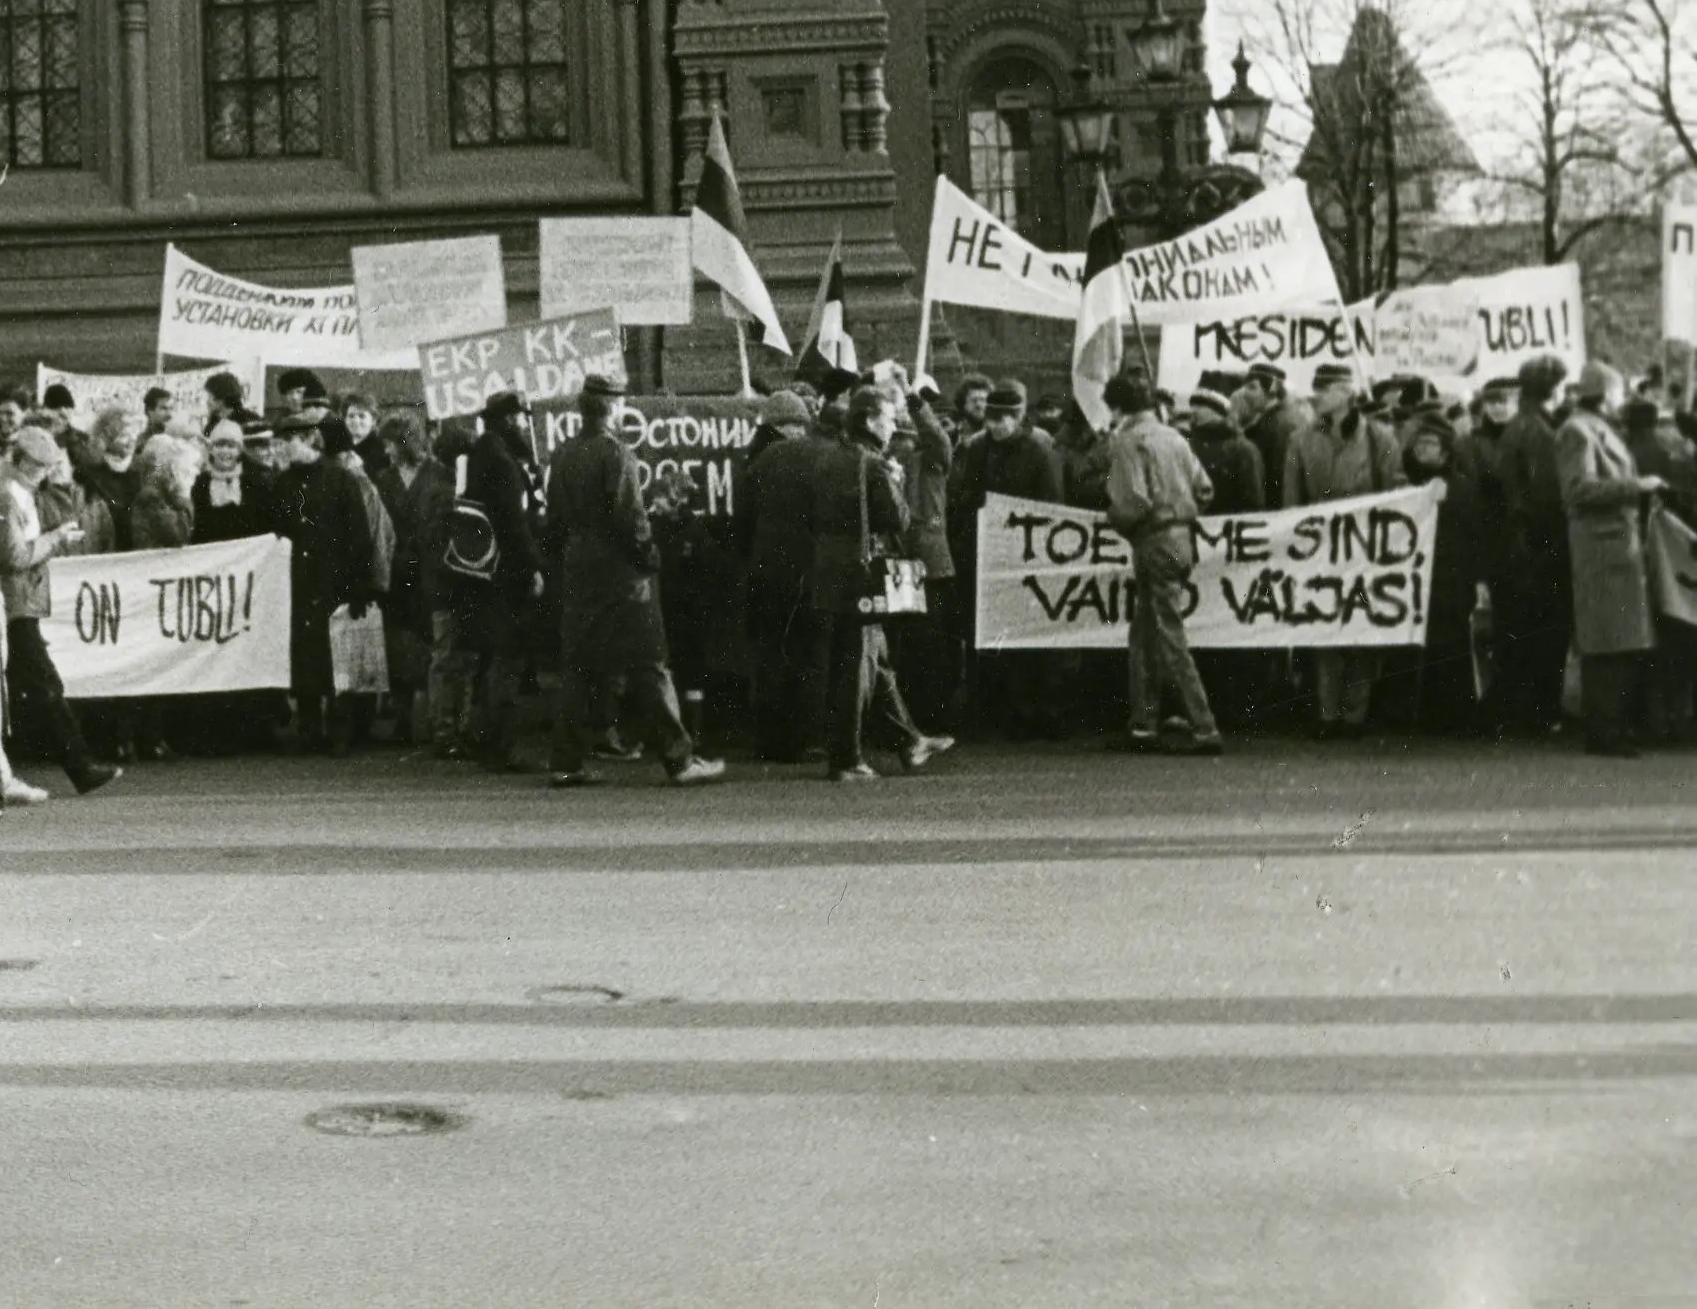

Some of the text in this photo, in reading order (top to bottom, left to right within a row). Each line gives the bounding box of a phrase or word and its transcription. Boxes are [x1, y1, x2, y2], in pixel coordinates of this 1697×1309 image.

[429, 341, 501, 378] EKP
[525, 320, 579, 363] KK
[1007, 508, 1425, 568] TOEME SIND,
[75, 581, 122, 645] ON
[149, 570, 255, 645] TUBLI!
[1221, 568, 1423, 626] VÄLJAS!
